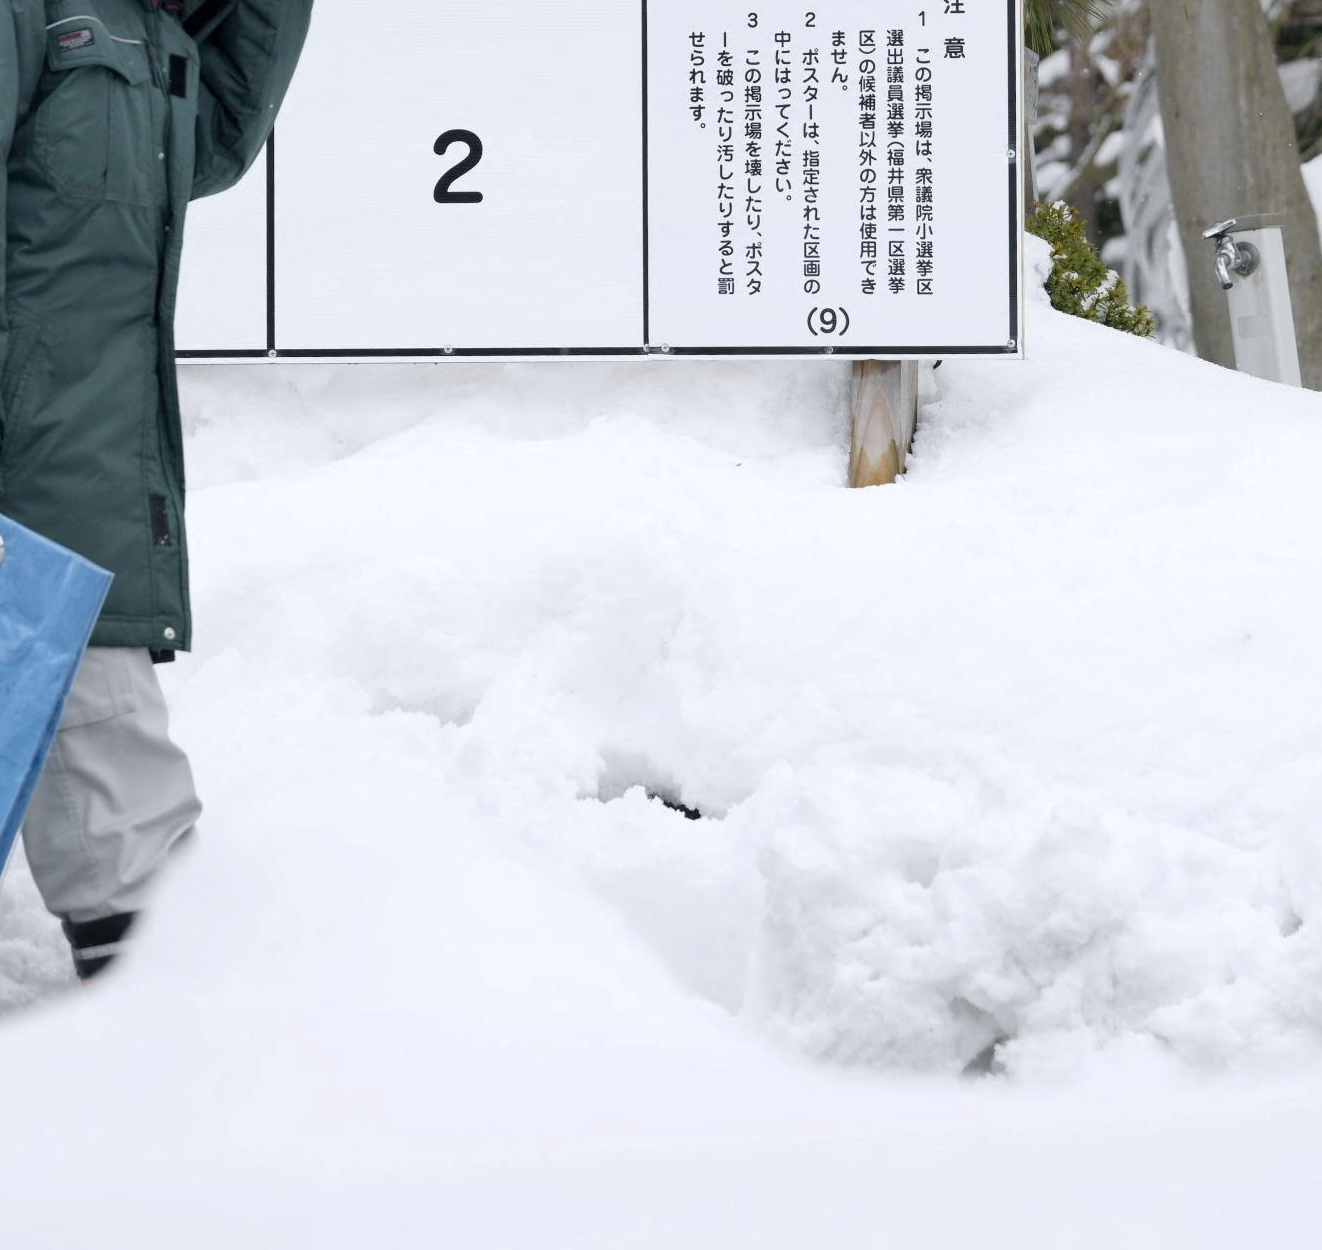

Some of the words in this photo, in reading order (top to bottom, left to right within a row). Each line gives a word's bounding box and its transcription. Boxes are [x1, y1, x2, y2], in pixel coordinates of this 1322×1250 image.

[689, 32, 706, 128] せられます。
[775, 31, 791, 200] 中にはってください。
[831, 31, 848, 90] ません。
[434, 129, 483, 203] 2
[717, 32, 734, 294] ーを破ったり汚したりすると罰
[859, 30, 877, 294] 区）の候補者以外の方は使用でき
[887, 30, 905, 294] 選出議員選挙（福井県第一区選挙
[807, 307, 849, 336] (9)
